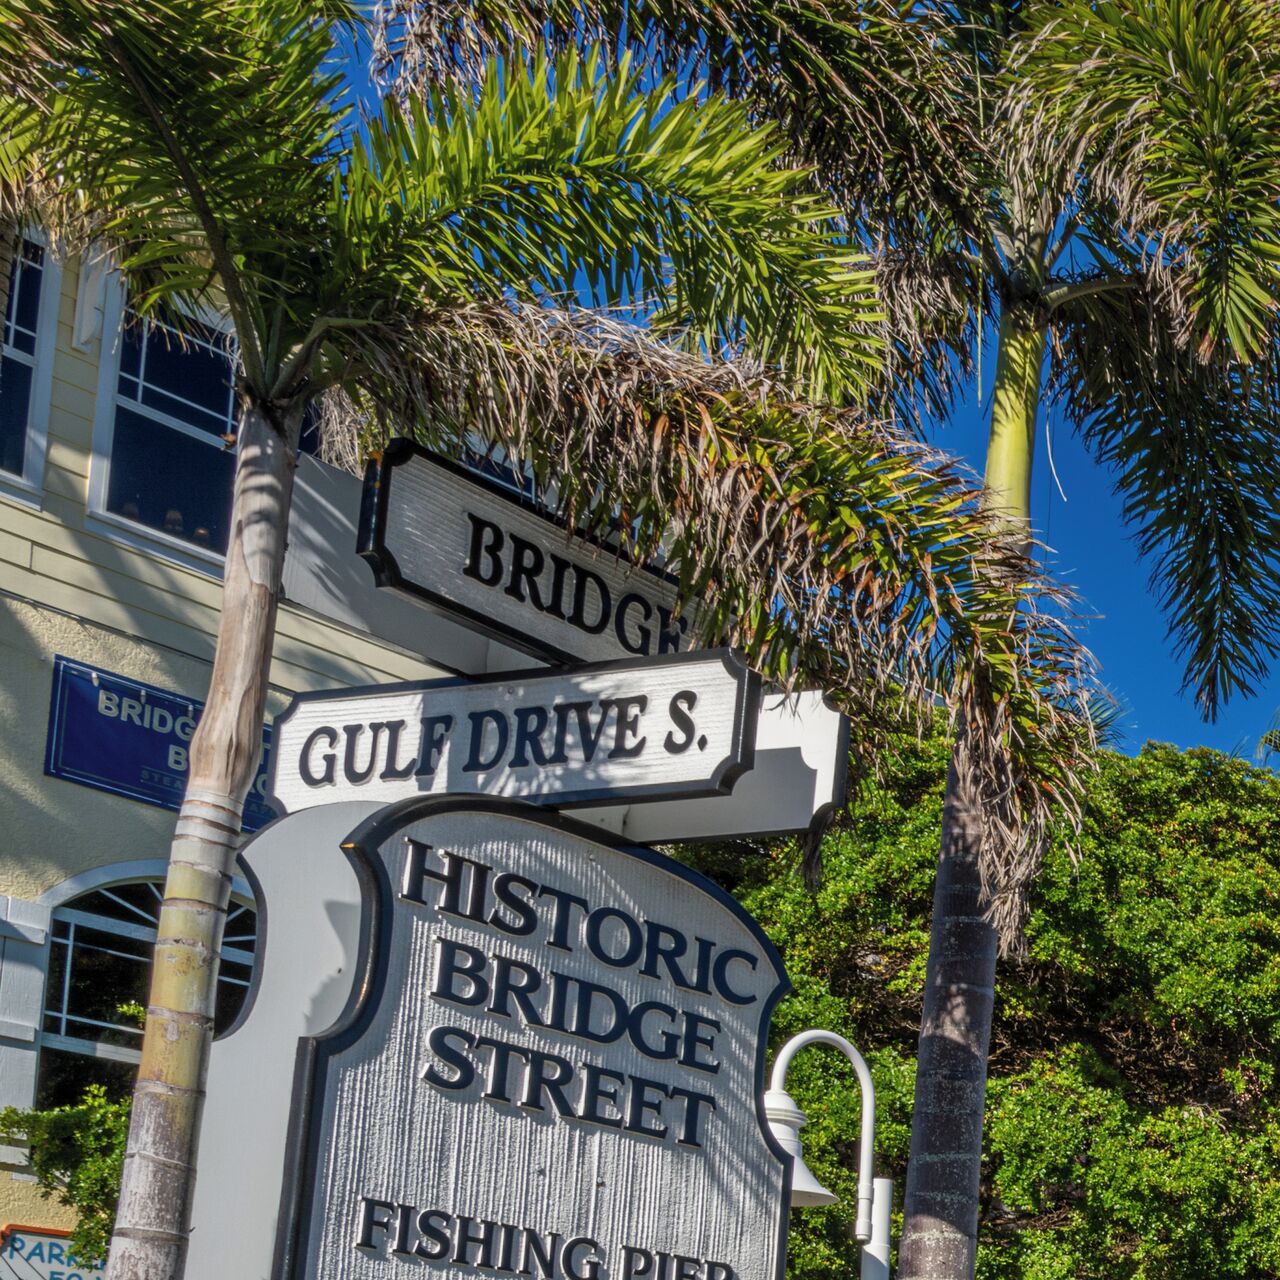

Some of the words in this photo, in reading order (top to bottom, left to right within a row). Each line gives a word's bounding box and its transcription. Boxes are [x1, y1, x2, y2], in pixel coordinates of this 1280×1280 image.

[463, 512, 688, 655] BRIDGE
[98, 690, 197, 742] BRIDG
[299, 714, 454, 788] GULF
[462, 694, 648, 773] DRIVE
[663, 690, 708, 754] S.
[399, 837, 759, 1006] HISTORIC
[430, 935, 721, 1074] BRIDGE
[422, 1025, 717, 1148] STREET
